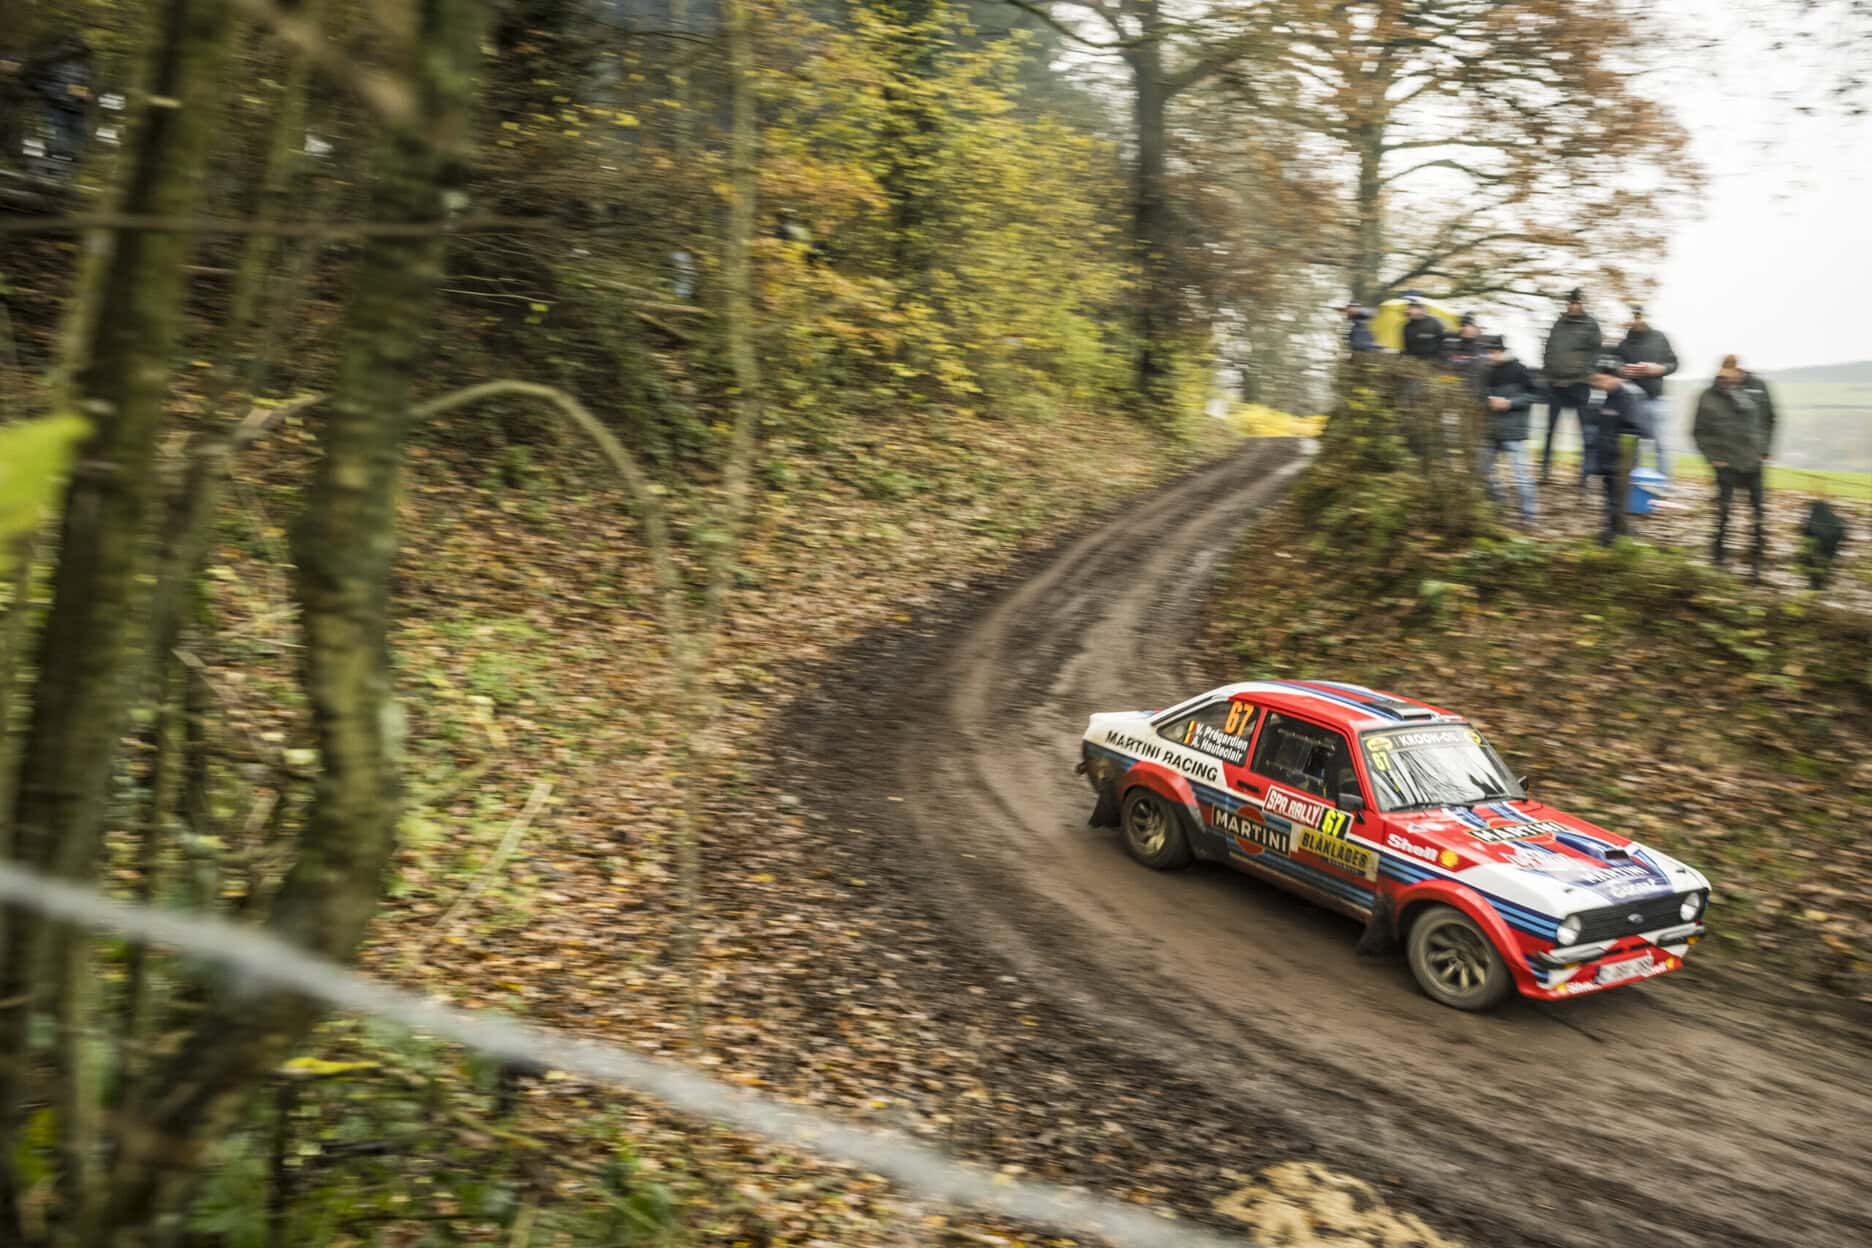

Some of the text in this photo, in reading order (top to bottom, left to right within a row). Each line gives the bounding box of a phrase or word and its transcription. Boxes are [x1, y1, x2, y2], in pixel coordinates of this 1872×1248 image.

[1225, 700, 1255, 737] 67
[1105, 730, 1219, 782] MARTINI RACING
[1200, 738, 1243, 763] Hauteclair
[1371, 751, 1392, 771] 67
[1215, 810, 1287, 851] MARTINI
[1287, 799, 1321, 827] RALLY
[1321, 809, 1346, 838] 67
[1473, 821, 1565, 843] MARTINI
[1387, 833, 1438, 862] Shell
